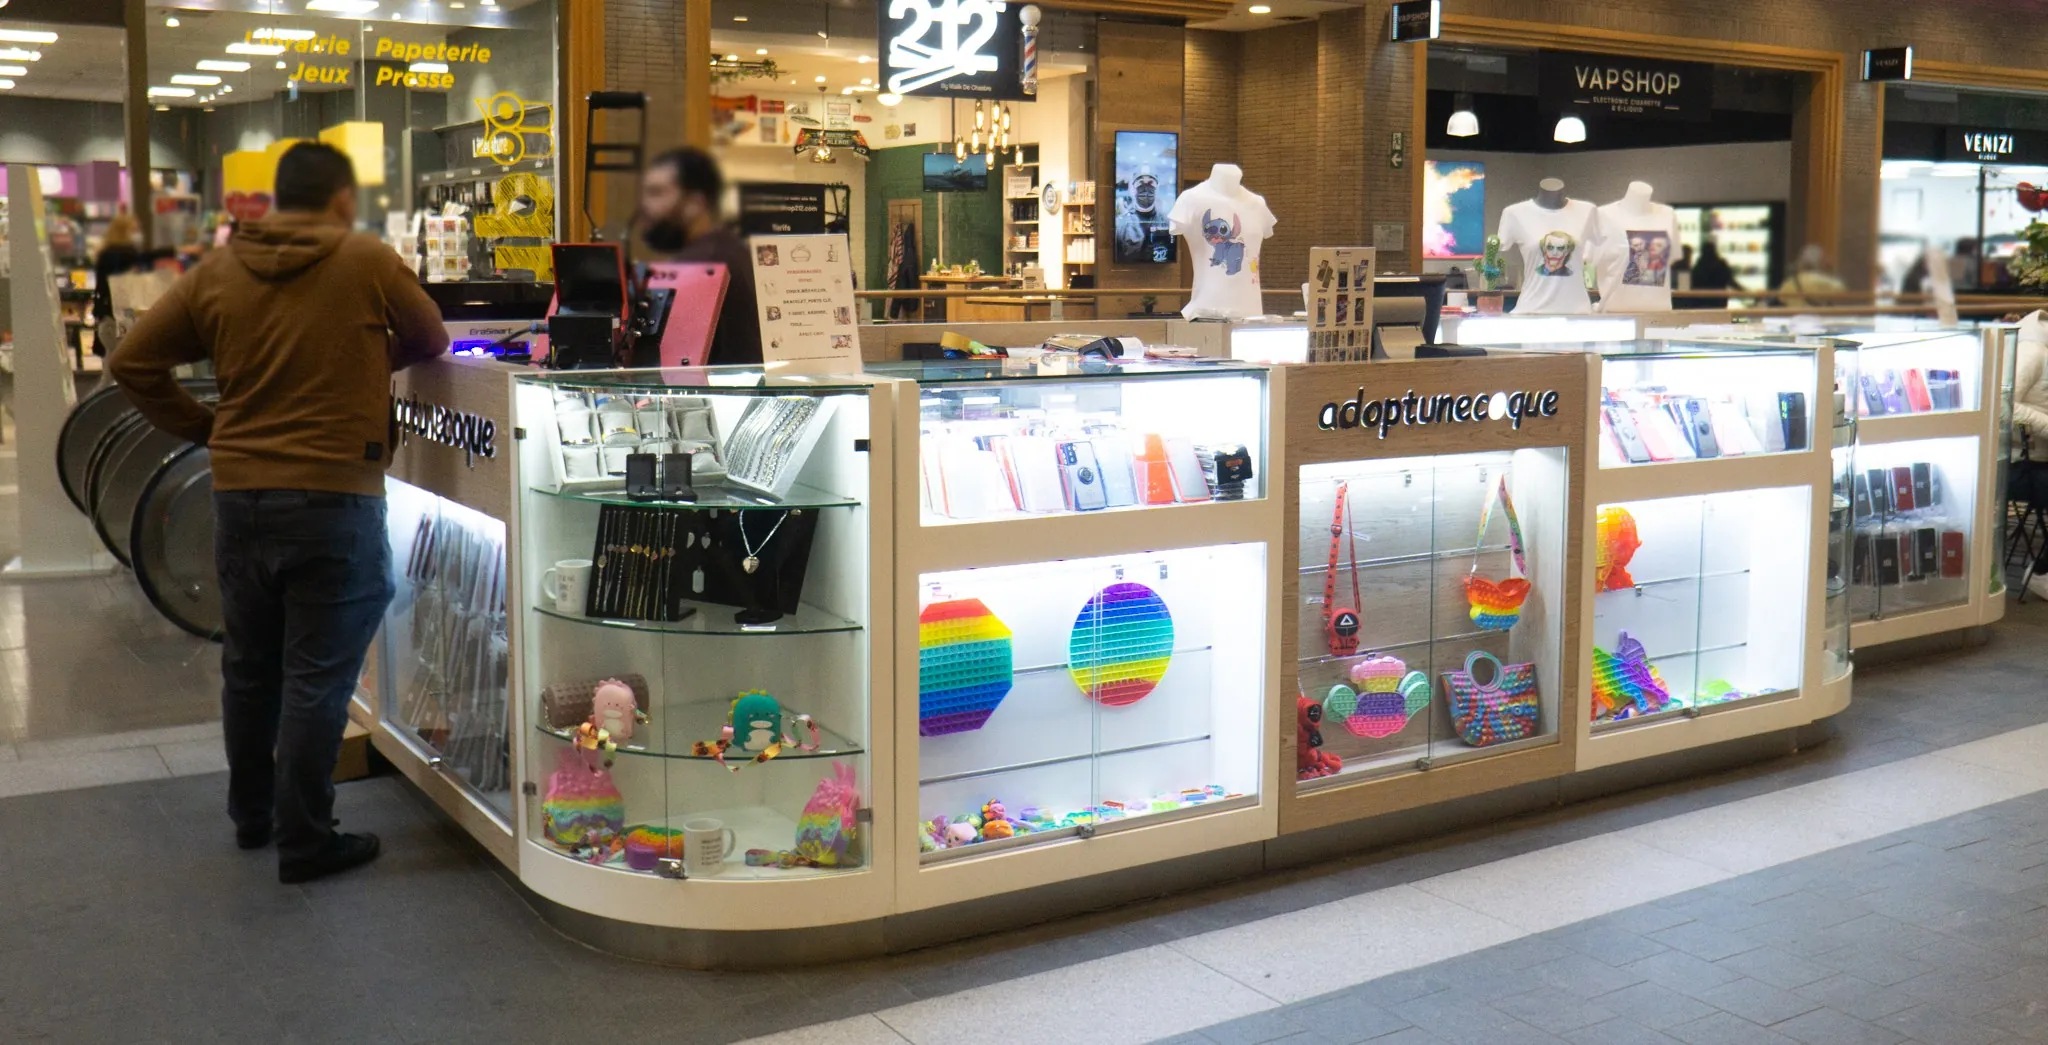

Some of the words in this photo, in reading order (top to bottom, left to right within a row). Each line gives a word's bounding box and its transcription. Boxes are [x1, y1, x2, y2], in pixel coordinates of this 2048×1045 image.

[375, 36, 492, 64] Papeterie
[888, 0, 1001, 76] 212
[289, 62, 351, 85] Jeux
[375, 65, 456, 89] Presse
[1575, 65, 1681, 95] VAPSHOP
[1963, 132, 2013, 154] VENIZI
[392, 381, 497, 468] optunecoque
[1318, 386, 1560, 440] adoptunecoque
